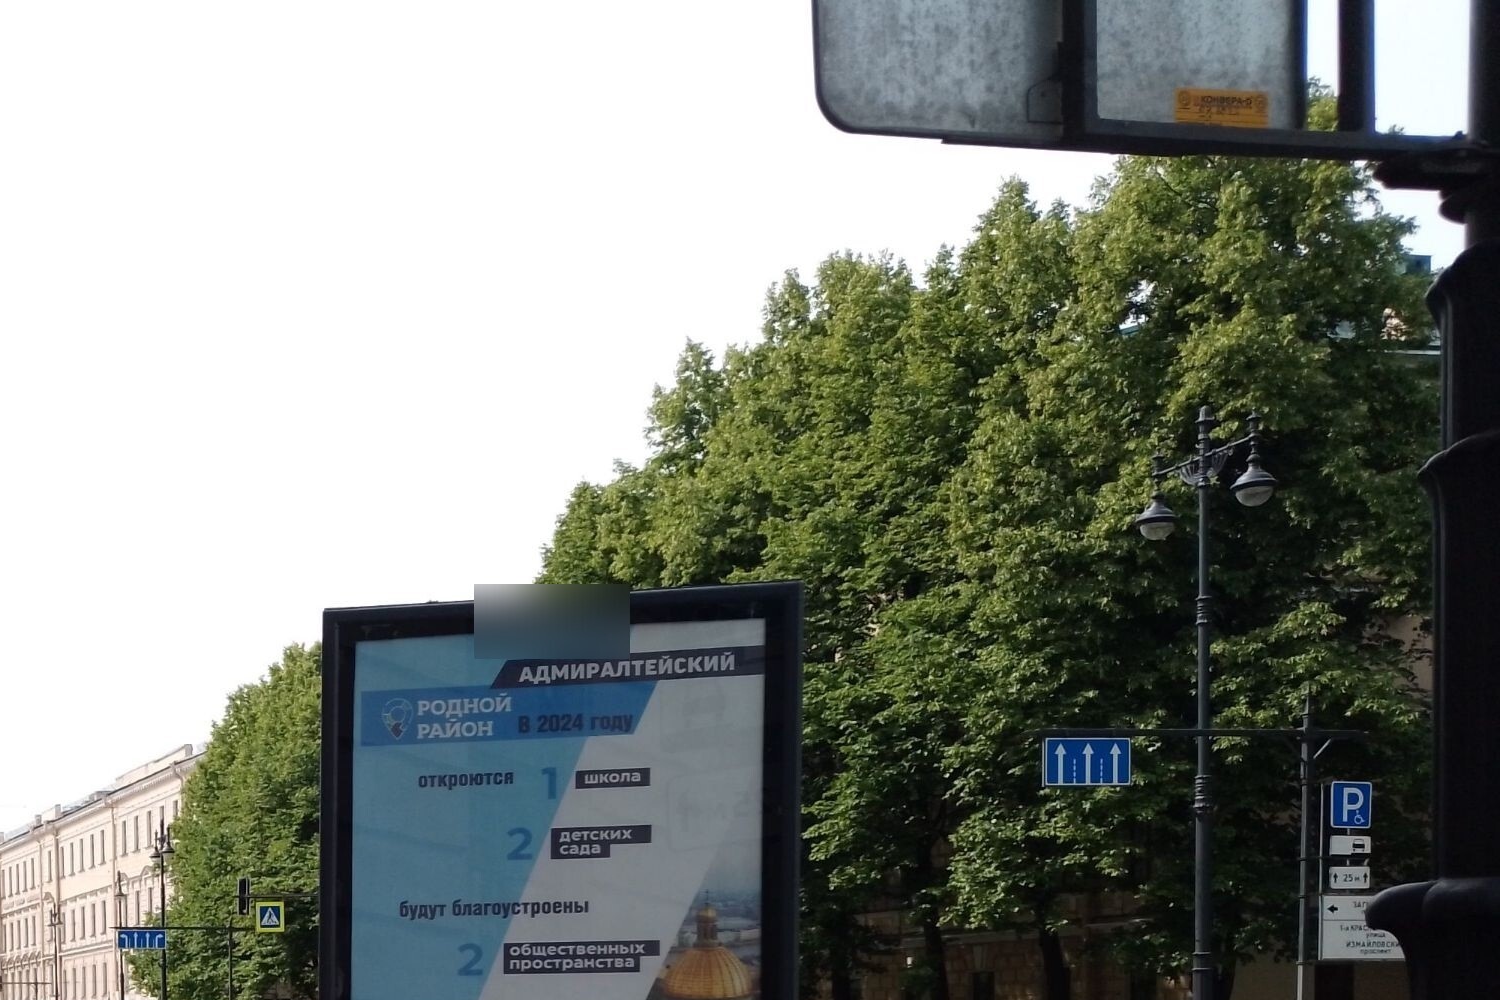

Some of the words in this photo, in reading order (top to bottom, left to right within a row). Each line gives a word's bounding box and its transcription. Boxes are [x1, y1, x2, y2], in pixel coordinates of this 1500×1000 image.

[518, 651, 736, 685] АДМИРАЛТЕЙСКИЙ
[416, 692, 512, 719] РОДНОЙ
[416, 717, 493, 740] РАЙОН
[518, 716, 531, 734] В
[536, 713, 583, 733] 2024
[590, 714, 634, 734] году
[417, 769, 514, 790] откроются
[541, 766, 558, 800] 1
[584, 769, 641, 785] школа
[506, 826, 533, 861] 2
[558, 827, 633, 844] детских
[559, 841, 602, 856] сада
[1343, 873, 1353, 882] 25
[399, 899, 447, 920] будут
[451, 899, 590, 919] благоустроены
[457, 942, 484, 976] 2
[509, 941, 646, 957] общественных
[509, 956, 636, 971] пространства
